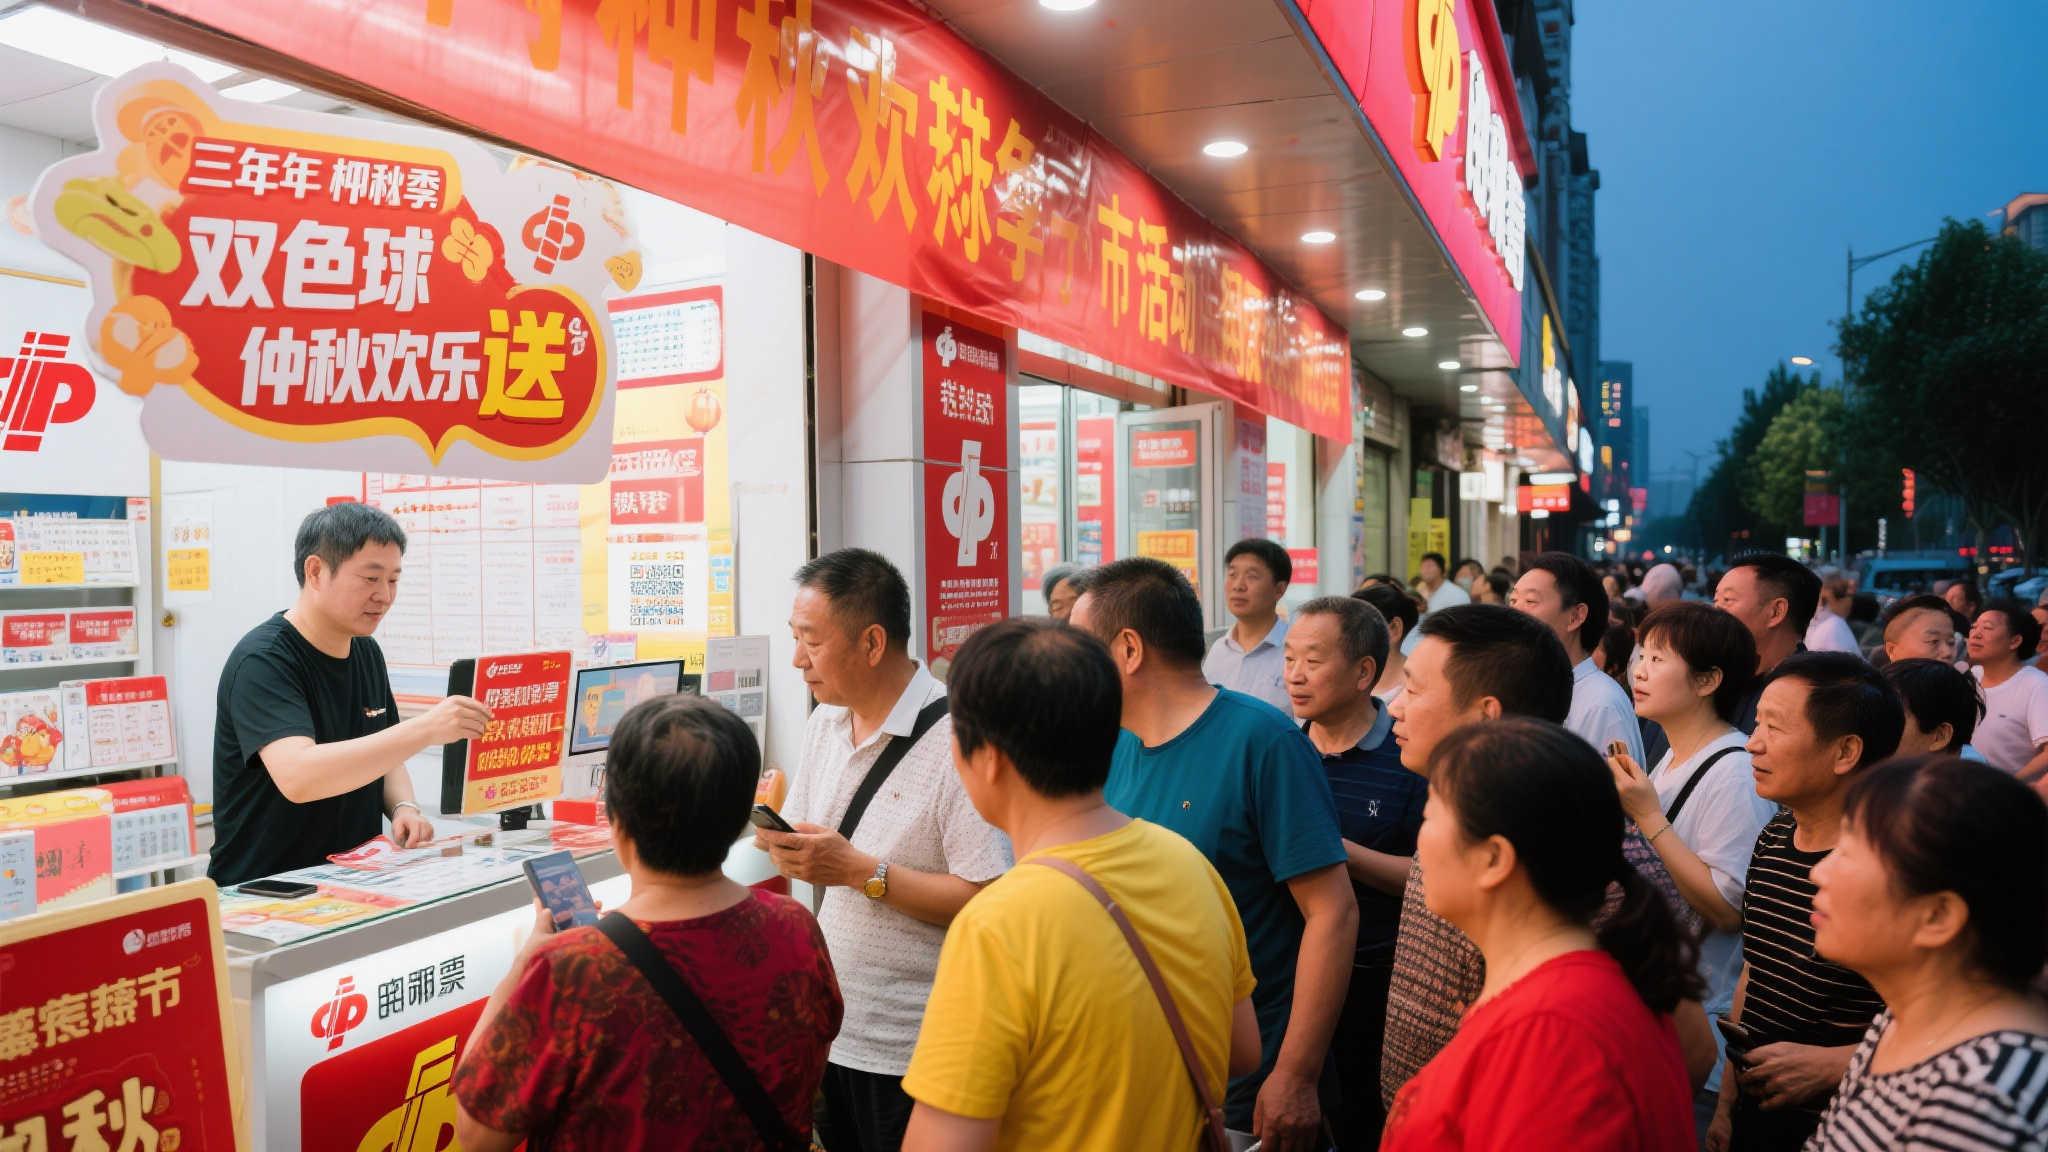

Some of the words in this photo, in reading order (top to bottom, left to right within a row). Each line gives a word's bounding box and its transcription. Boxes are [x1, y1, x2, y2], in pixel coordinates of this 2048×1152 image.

[188, 141, 323, 199] 三年年
[179, 216, 434, 312] 双色球
[240, 309, 566, 419] 仲秋欢乐送
